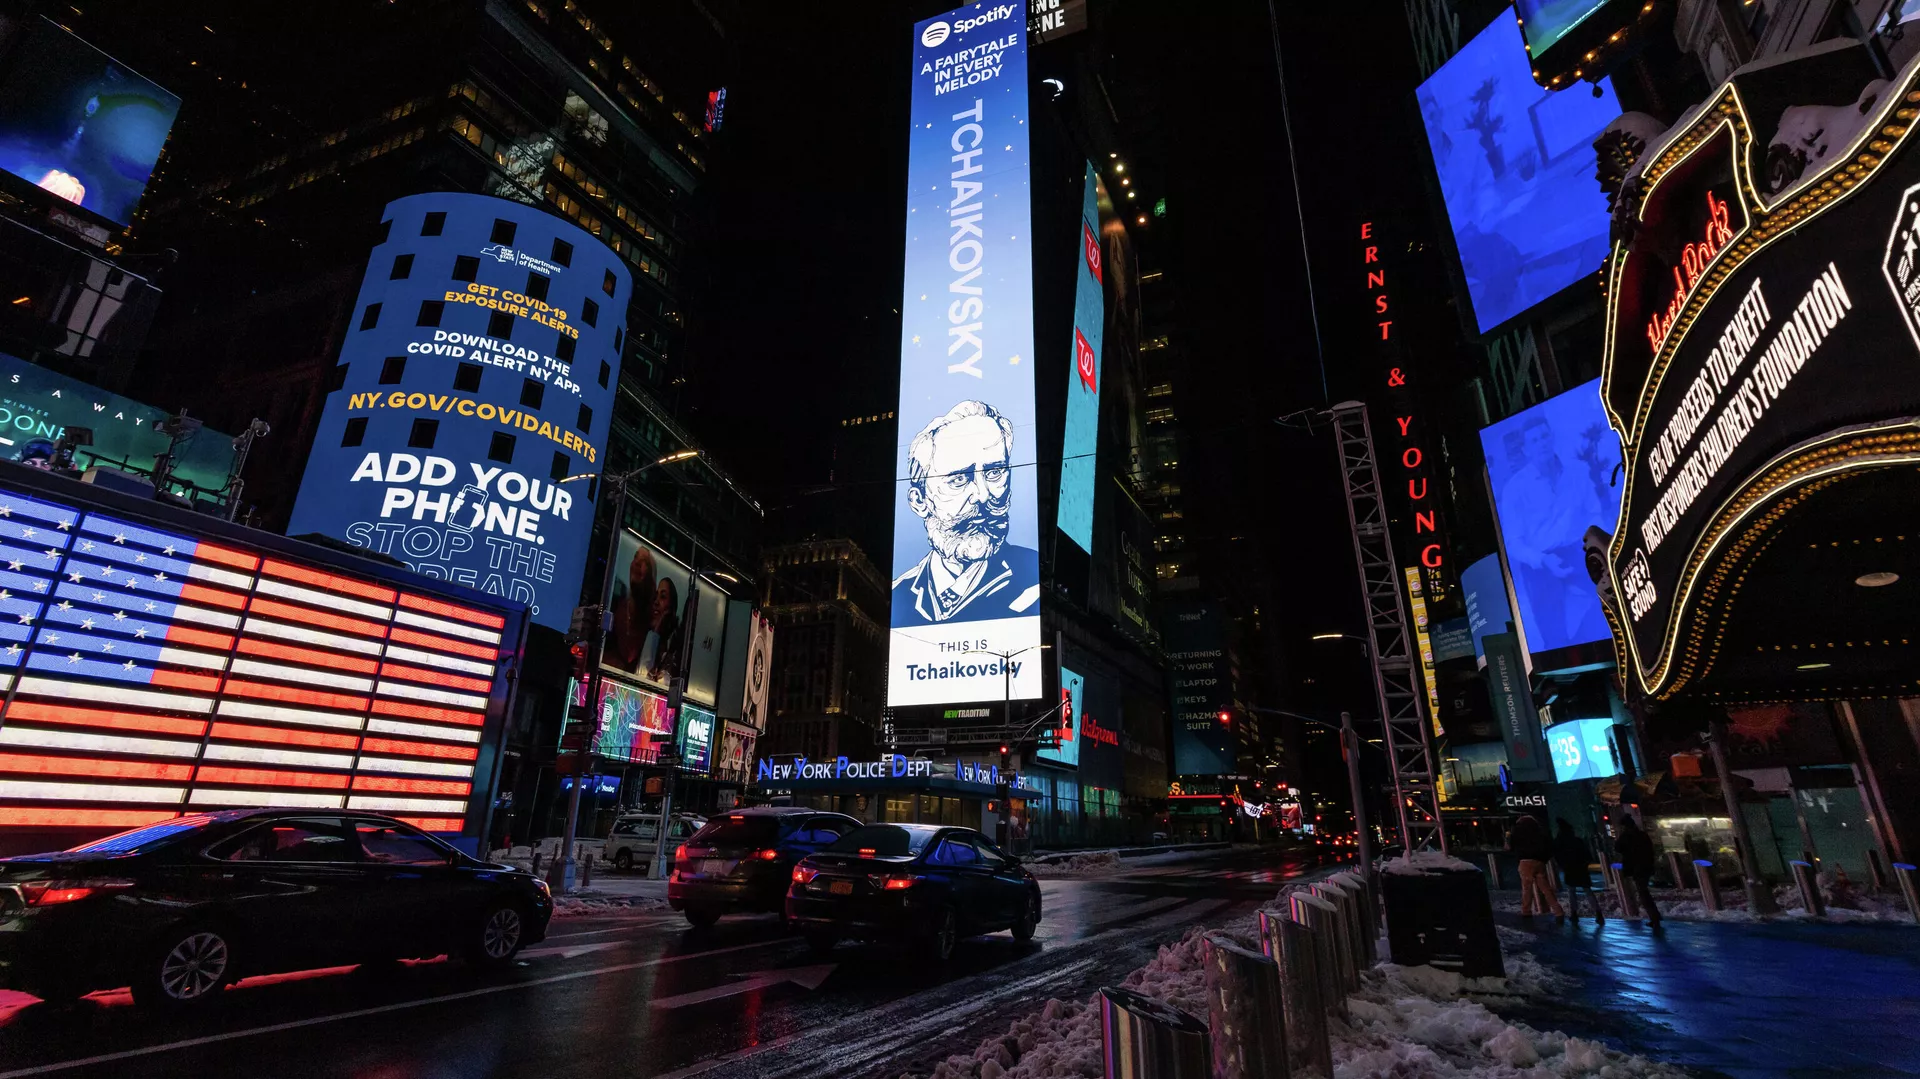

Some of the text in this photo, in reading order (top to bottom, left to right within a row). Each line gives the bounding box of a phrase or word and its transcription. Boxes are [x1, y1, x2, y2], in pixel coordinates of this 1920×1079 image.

[953, 4, 1016, 33] Spotify
[921, 33, 1017, 75] A FAIRYTALE
[934, 51, 1004, 83] IN EVERY
[935, 64, 1003, 96] MELODY
[947, 98, 983, 379] TCHAIKOVSKY
[520, 253, 561, 273] Department
[527, 262, 550, 275] Health
[1647, 190, 1733, 353] Hard Rock
[444, 291, 579, 339] EXPOSURE ALERTS
[467, 283, 567, 321] GET COVID-19
[407, 342, 582, 398] COVID ALERT NY APP.
[433, 329, 570, 377] DOWNLOAD THE
[1361, 222, 1442, 568] ERNST & YOUNG
[1649, 276, 1771, 487] 15% OF PROCEEDS TO BENEFIT
[4, 398, 49, 418] WINNER
[52, 390, 61, 398] A
[93, 402, 143, 426] WAY
[1641, 261, 1852, 555] FIRST RESPONDERS CHILDREN'S FOUNDATION
[348, 391, 597, 463] NY.GOV/COVIDALERTS
[350, 452, 573, 521] ADD YOUR
[345, 521, 557, 584] STOP THE
[1630, 580, 1657, 622] SOUND
[939, 639, 988, 652] THIS IS
[906, 657, 1022, 681] Tchaikovsky
[1183, 679, 1217, 687] LAPTOP
[1187, 662, 1214, 670] WORK
[944, 708, 990, 719] NEWTRADITION
[1498, 654, 1521, 737] THOMSON REUTERS
[688, 719, 710, 742] ONE
[1187, 722, 1211, 730] SUIT?
[758, 754, 932, 781] NEW YORK POLICE DEPT
[956, 758, 973, 782] NEW
[974, 761, 991, 784] YORK
